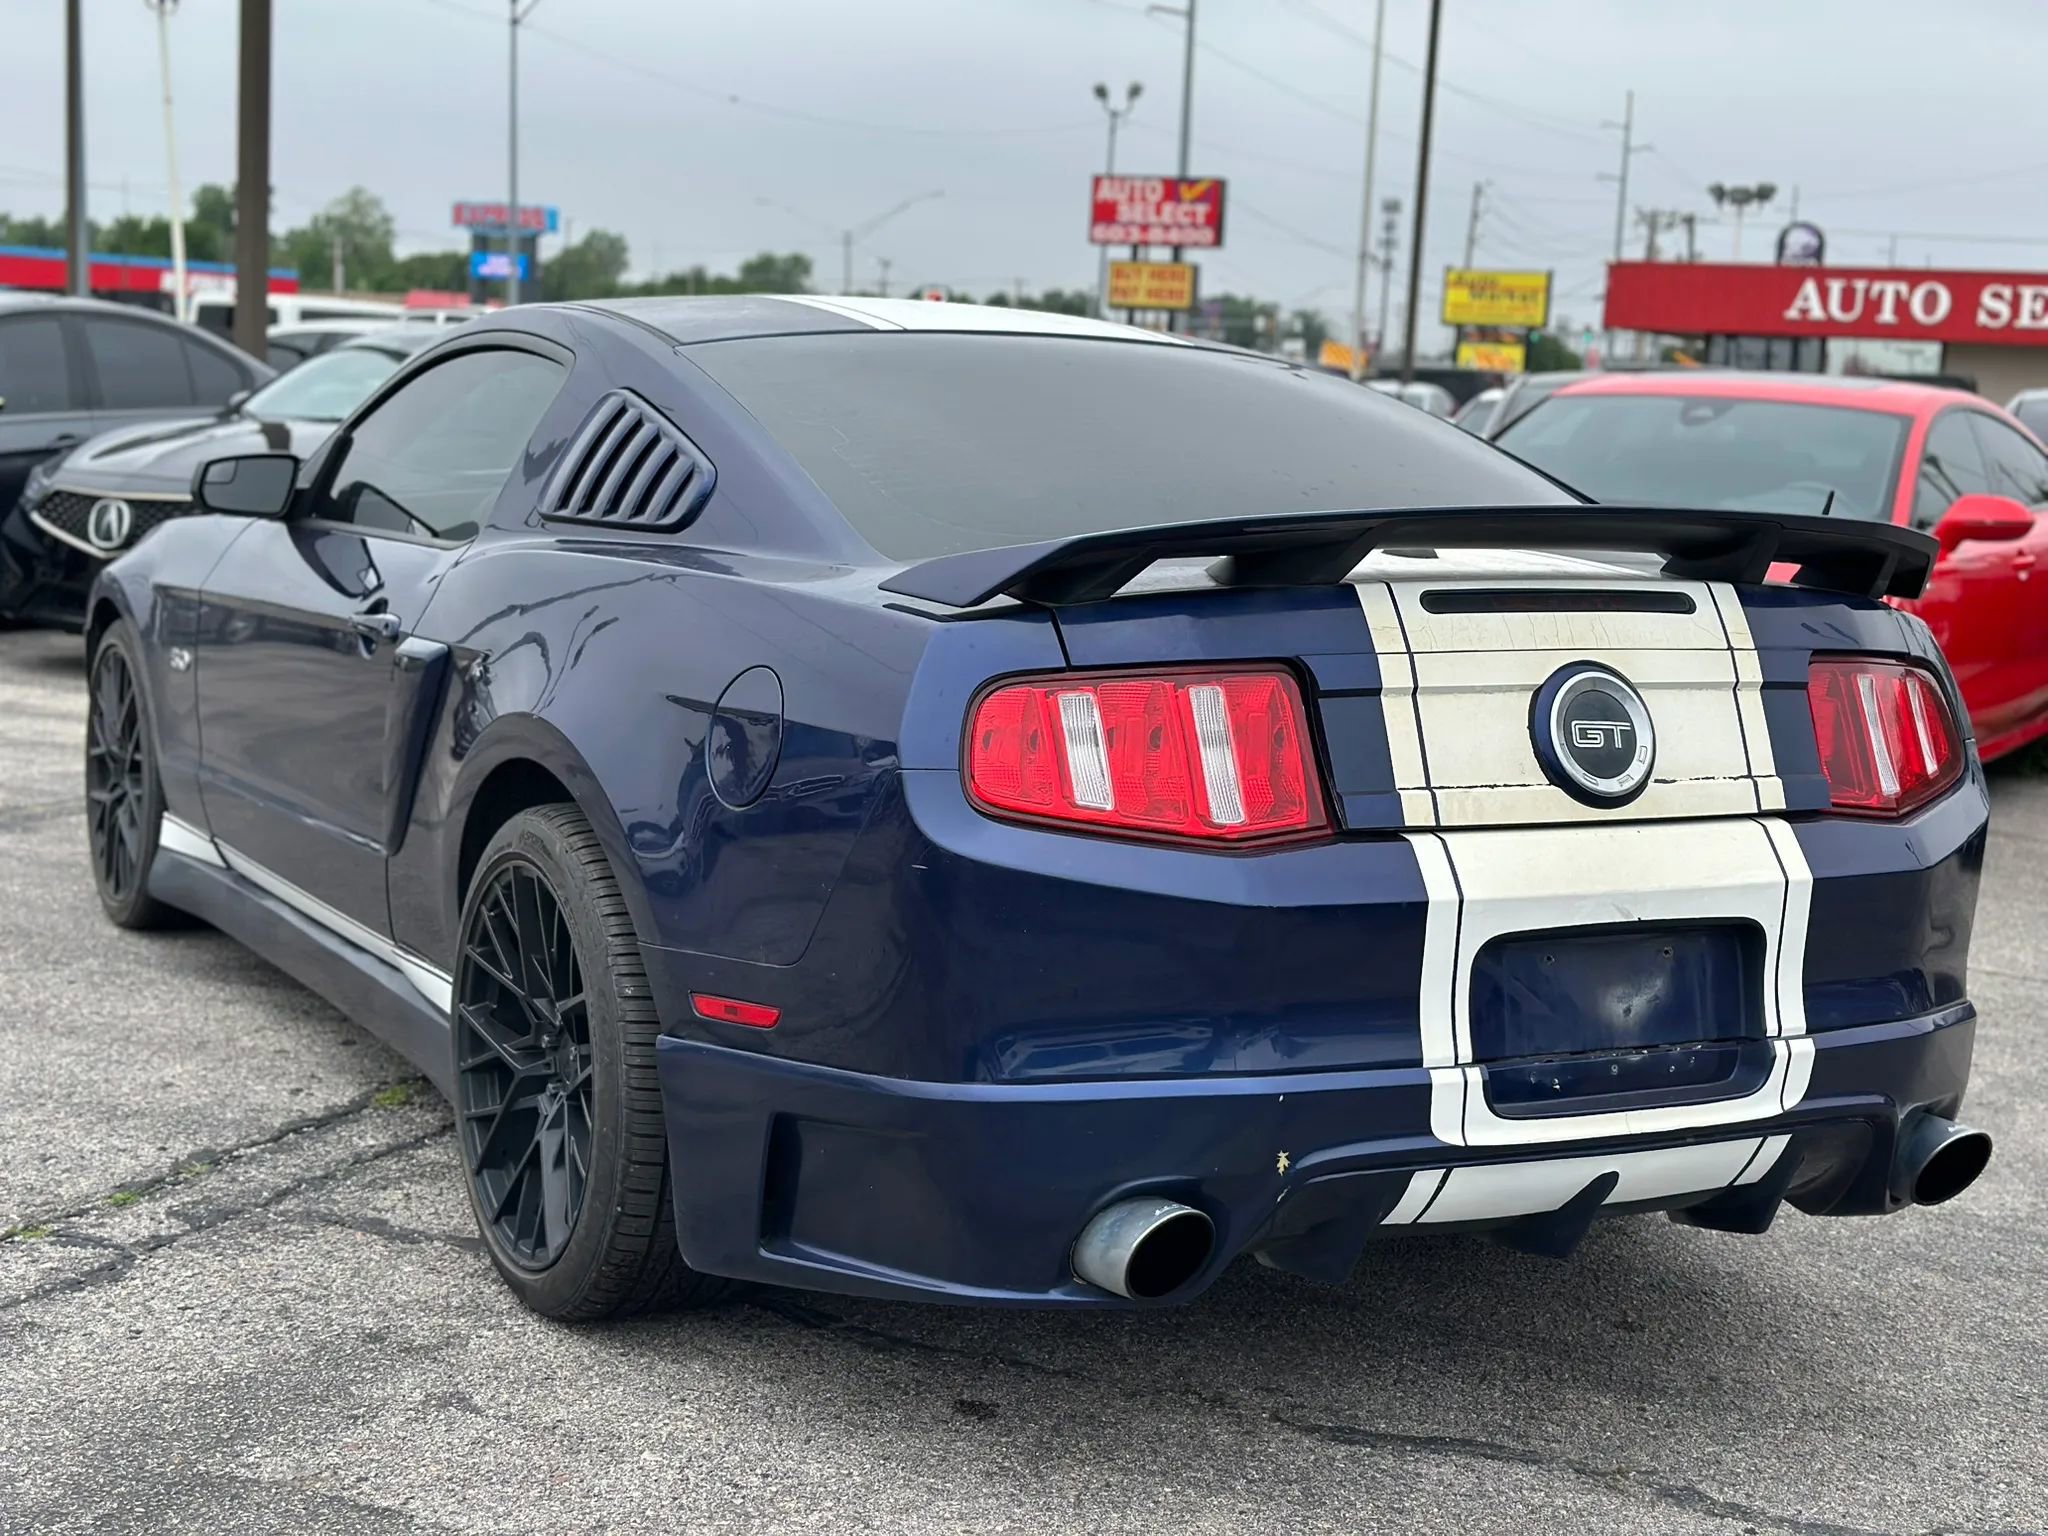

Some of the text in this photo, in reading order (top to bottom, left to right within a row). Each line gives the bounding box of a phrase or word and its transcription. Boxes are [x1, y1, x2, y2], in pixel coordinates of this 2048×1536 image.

[1095, 178, 1164, 202] AUTO
[453, 205, 545, 229] EXPRSS
[1116, 201, 1212, 224] SELECT
[1783, 276, 2048, 330] AUTO SE
[1571, 719, 1632, 749] GT
